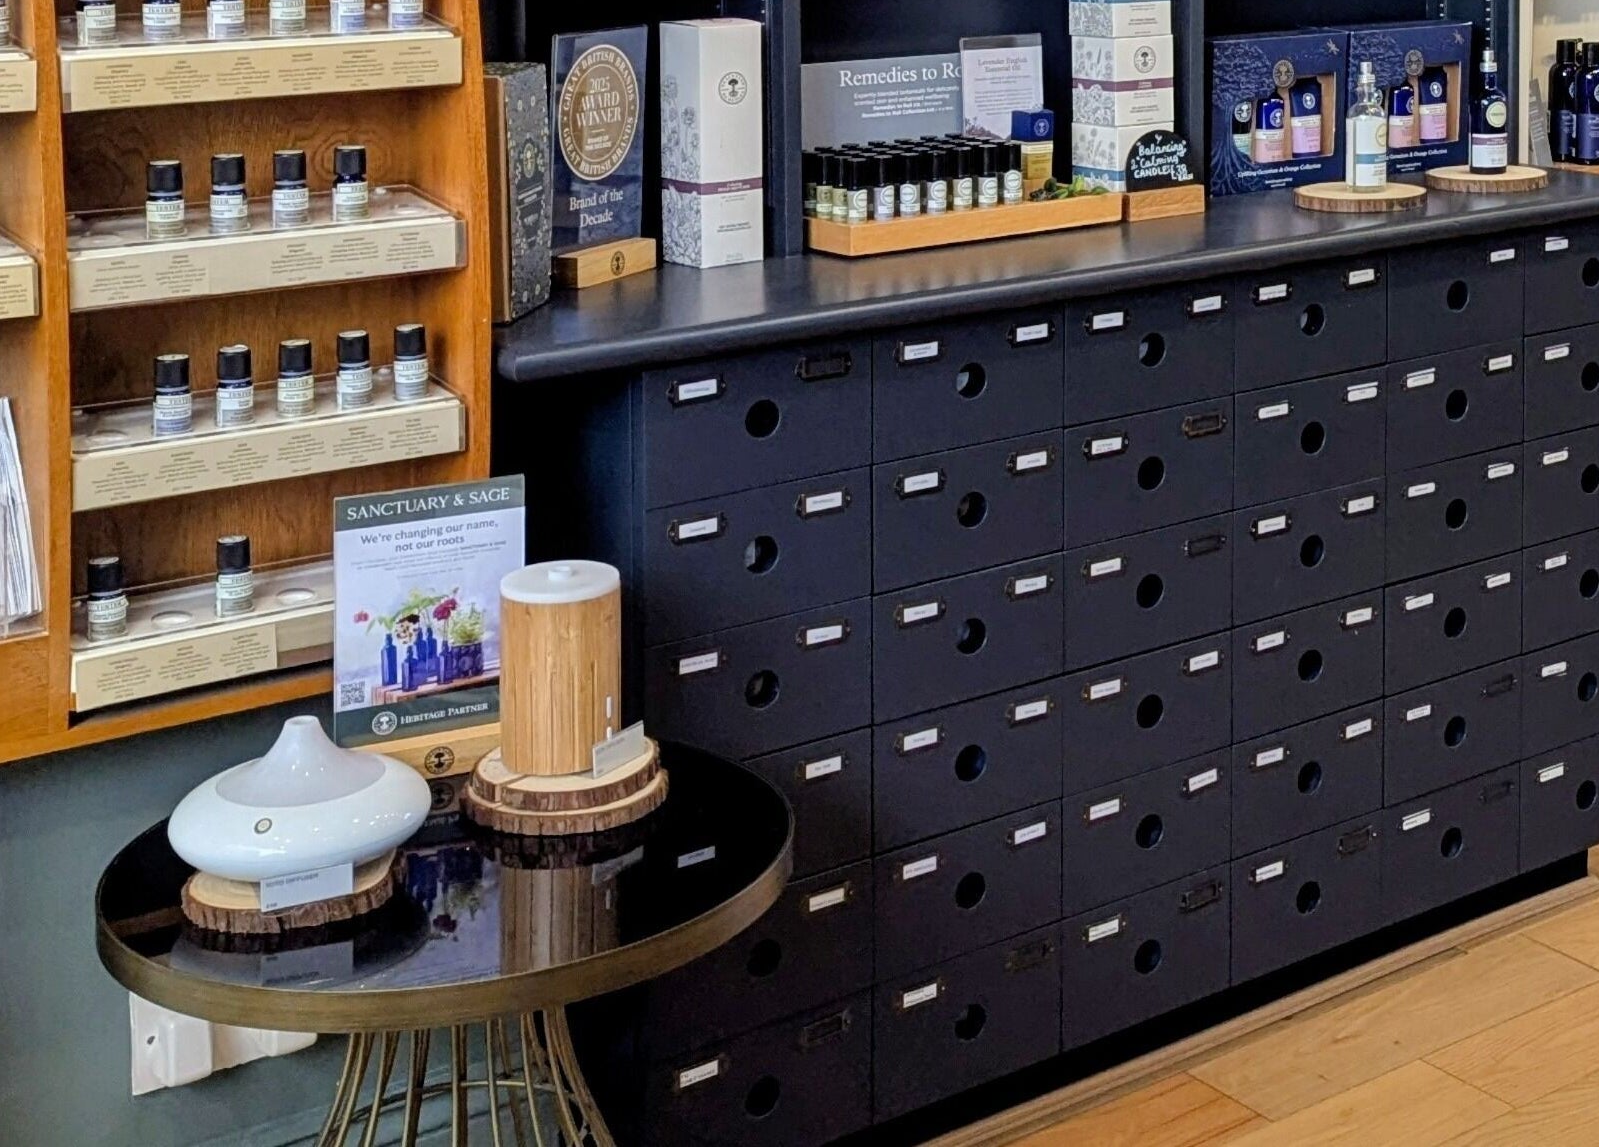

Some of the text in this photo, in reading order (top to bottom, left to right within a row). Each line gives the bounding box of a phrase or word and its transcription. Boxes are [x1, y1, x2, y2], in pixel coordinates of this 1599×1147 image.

[563, 51, 635, 110] GREAT BRITISH BRANDS
[590, 76, 610, 93] 2025
[840, 65, 937, 87] Remedies to
[581, 91, 620, 111] AWARD
[576, 107, 621, 127] WINNER
[563, 128, 581, 165] GREAT
[580, 160, 611, 175] BRITISH
[612, 116, 633, 163] BRANDS
[1237, 169, 1257, 178] Uplifting
[1257, 167, 1278, 175] Geranium
[1300, 163, 1321, 171] Collection
[155, 204, 181, 212] TESTER
[569, 188, 623, 210] Brand of the
[580, 208, 613, 228] Decade
[285, 380, 310, 388] TESTER
[347, 488, 510, 520] SANCTUARY & SAGE
[360, 520, 498, 545] We're changing our name,
[395, 535, 464, 553] not our roots
[400, 702, 489, 725] HERITAGE PARTNER
